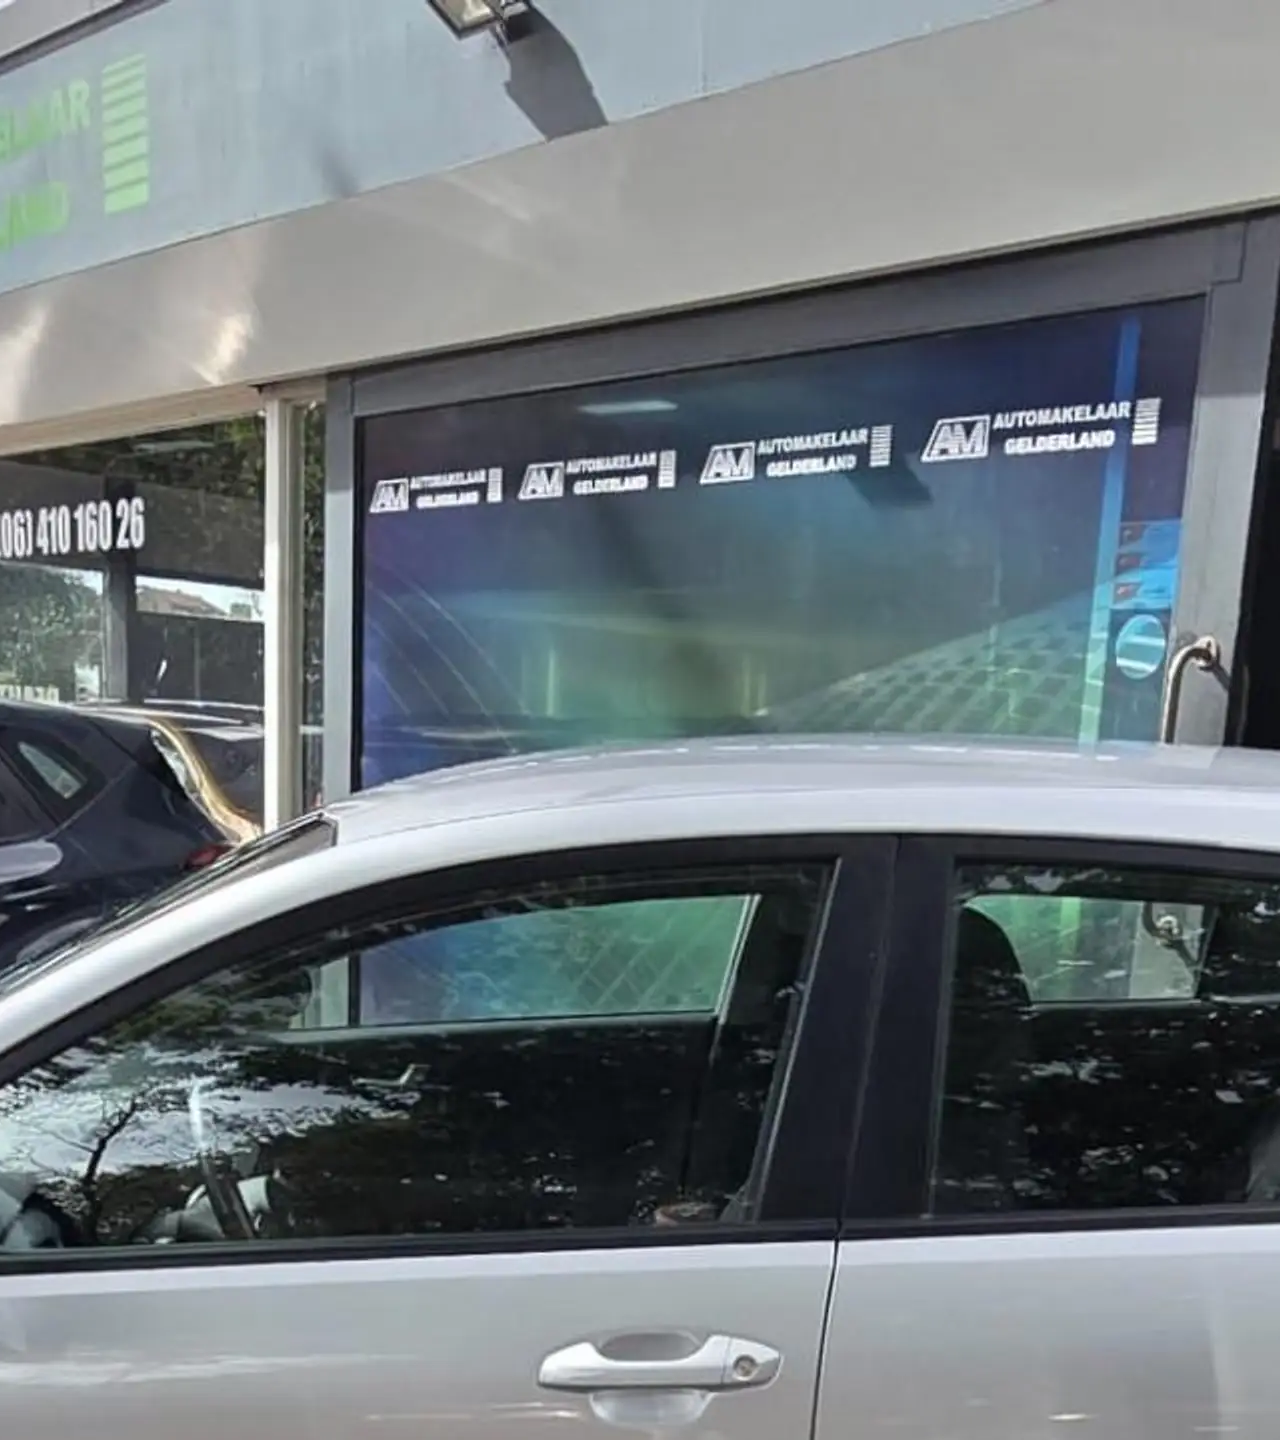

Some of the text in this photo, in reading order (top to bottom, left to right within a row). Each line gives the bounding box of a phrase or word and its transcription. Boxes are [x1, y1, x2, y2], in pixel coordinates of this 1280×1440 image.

[993, 401, 1131, 430] AUTOMAKELAAR
[757, 428, 868, 455] AUTOMAKELAAR
[928, 420, 987, 458] AM
[1005, 430, 1115, 455] GELDERLAND
[706, 446, 754, 479] AM
[766, 454, 857, 477] GELDERLAND
[36, 504, 71, 555] 410
[73, 500, 113, 553] 160
[116, 496, 147, 549] 26
